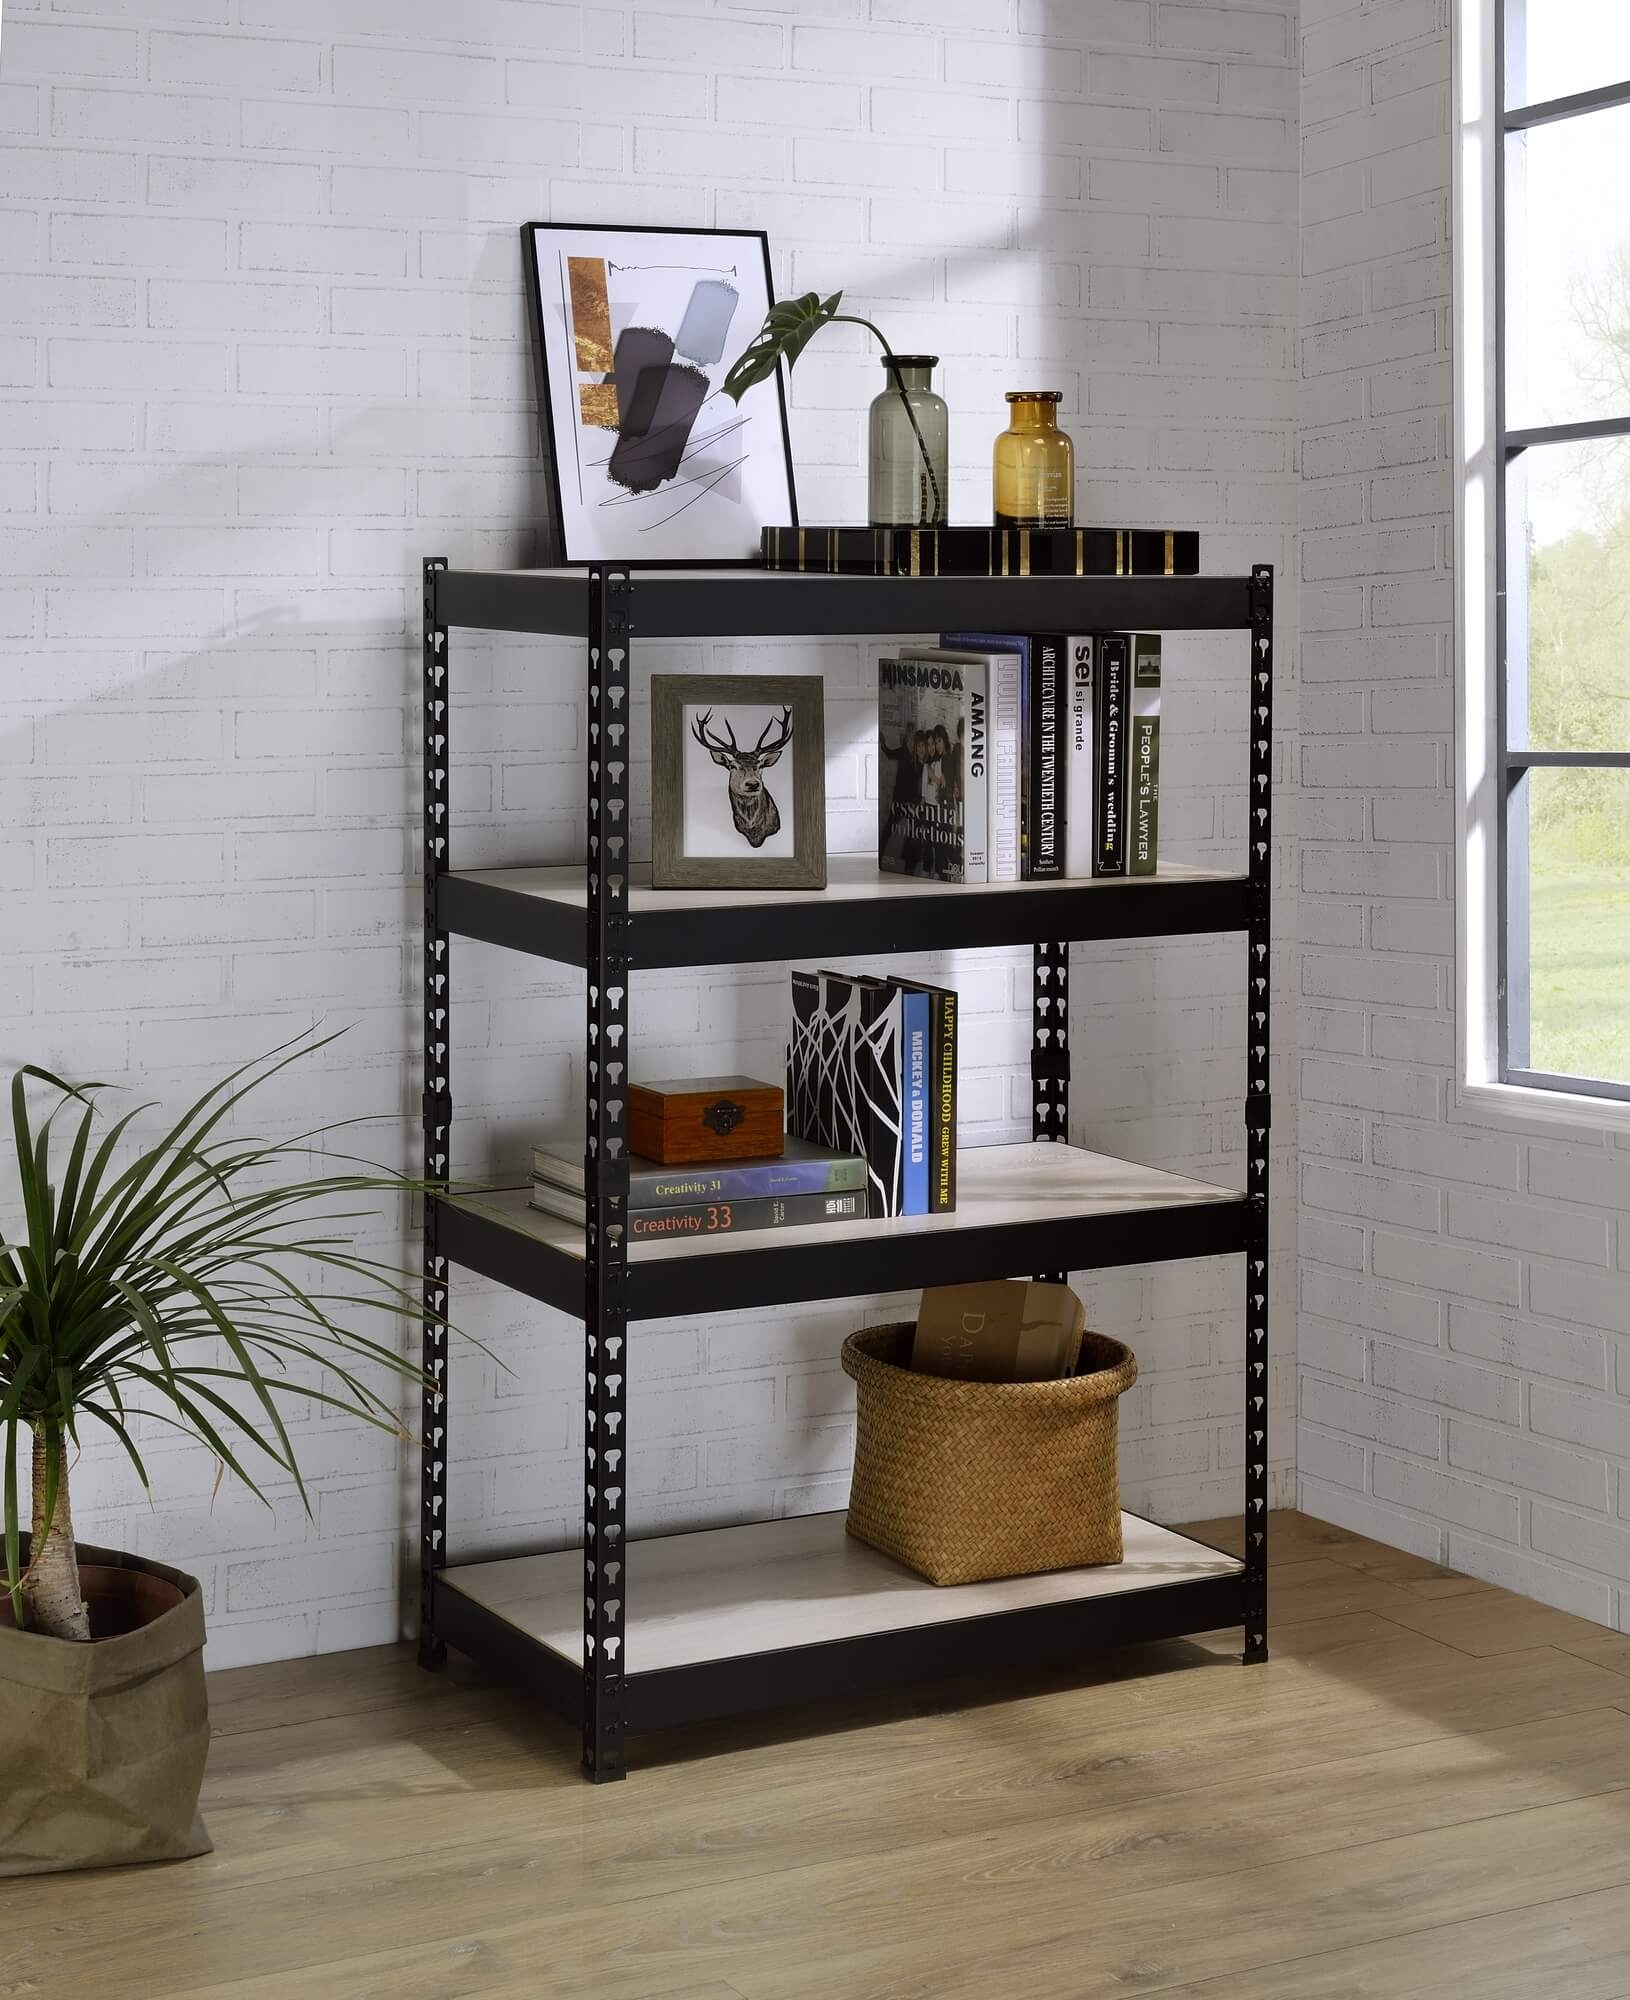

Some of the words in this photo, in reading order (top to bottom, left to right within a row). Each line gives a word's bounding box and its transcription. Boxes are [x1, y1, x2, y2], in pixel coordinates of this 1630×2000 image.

[1075, 690, 1085, 703] si
[1108, 703, 1119, 718] &
[971, 692, 985, 778] AMANG
[1041, 721, 1056, 732] IN
[1041, 733, 1056, 754] THE
[1073, 704, 1085, 751] grande
[996, 739, 1017, 819] FAMILY
[1040, 754, 1055, 811] TWENTIETH
[1139, 724, 1153, 796] PEOPLE'S
[1040, 811, 1055, 857] CENTURY
[1104, 791, 1117, 851] wedding
[1137, 798, 1151, 861] LAWYER
[995, 828, 1017, 877] MAN
[943, 996, 955, 1040] HAPPY
[911, 1031, 923, 1088] MICKEY
[941, 1042, 954, 1123] CHILDHOOD
[911, 1099, 924, 1163] DONALD
[941, 1126, 951, 1157] GREW
[655, 1182, 707, 1196] Creativity
[940, 1157, 950, 1186] WITH
[633, 1215, 702, 1233] Creativity
[706, 1205, 733, 1230] 33
[939, 1187, 949, 1205] ME
